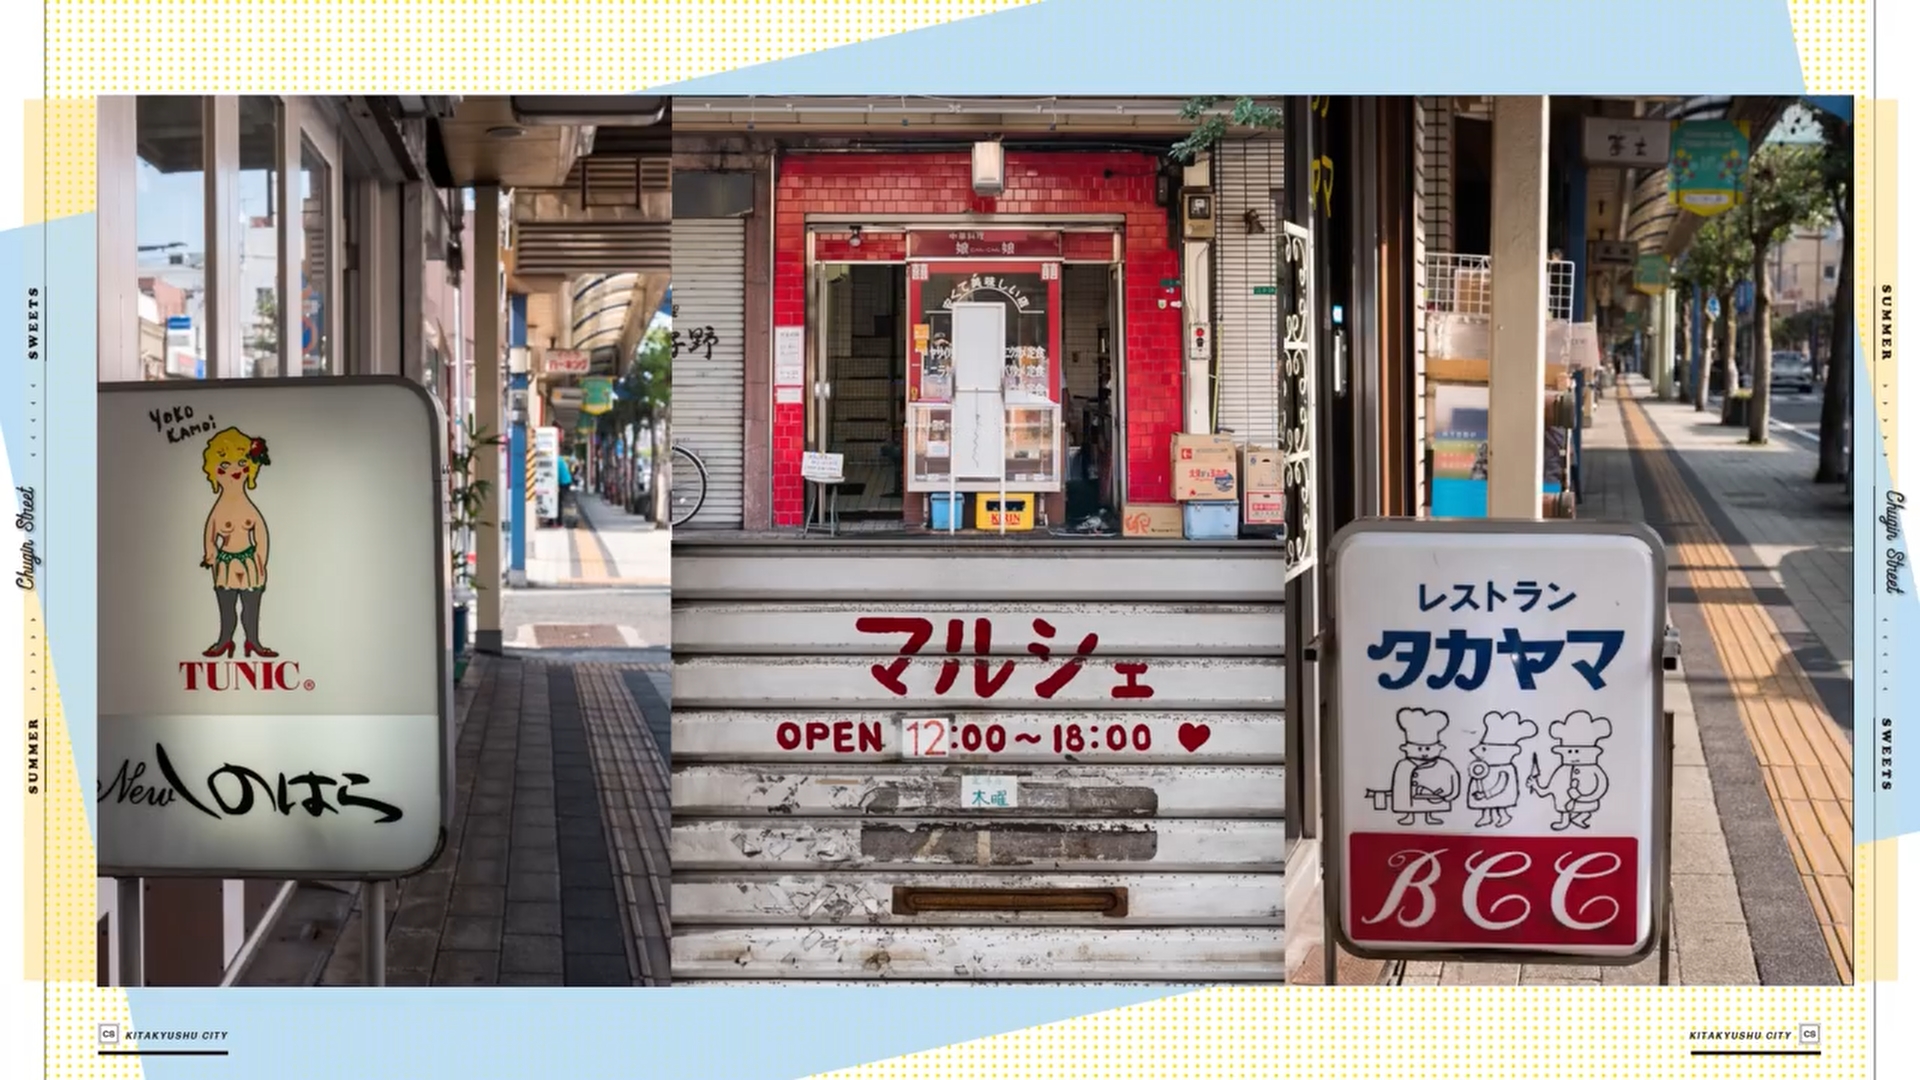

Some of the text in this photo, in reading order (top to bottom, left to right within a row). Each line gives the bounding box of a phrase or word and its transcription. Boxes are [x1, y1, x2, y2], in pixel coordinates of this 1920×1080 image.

[149, 405, 194, 432] YOKO
[1419, 581, 1578, 612] レストラン
[856, 617, 1155, 699] マルシェ
[1367, 628, 1626, 691] タカヤマ
[776, 721, 882, 752] OPEN
[98, 759, 176, 807] New
[972, 789, 1009, 807] 木曜
